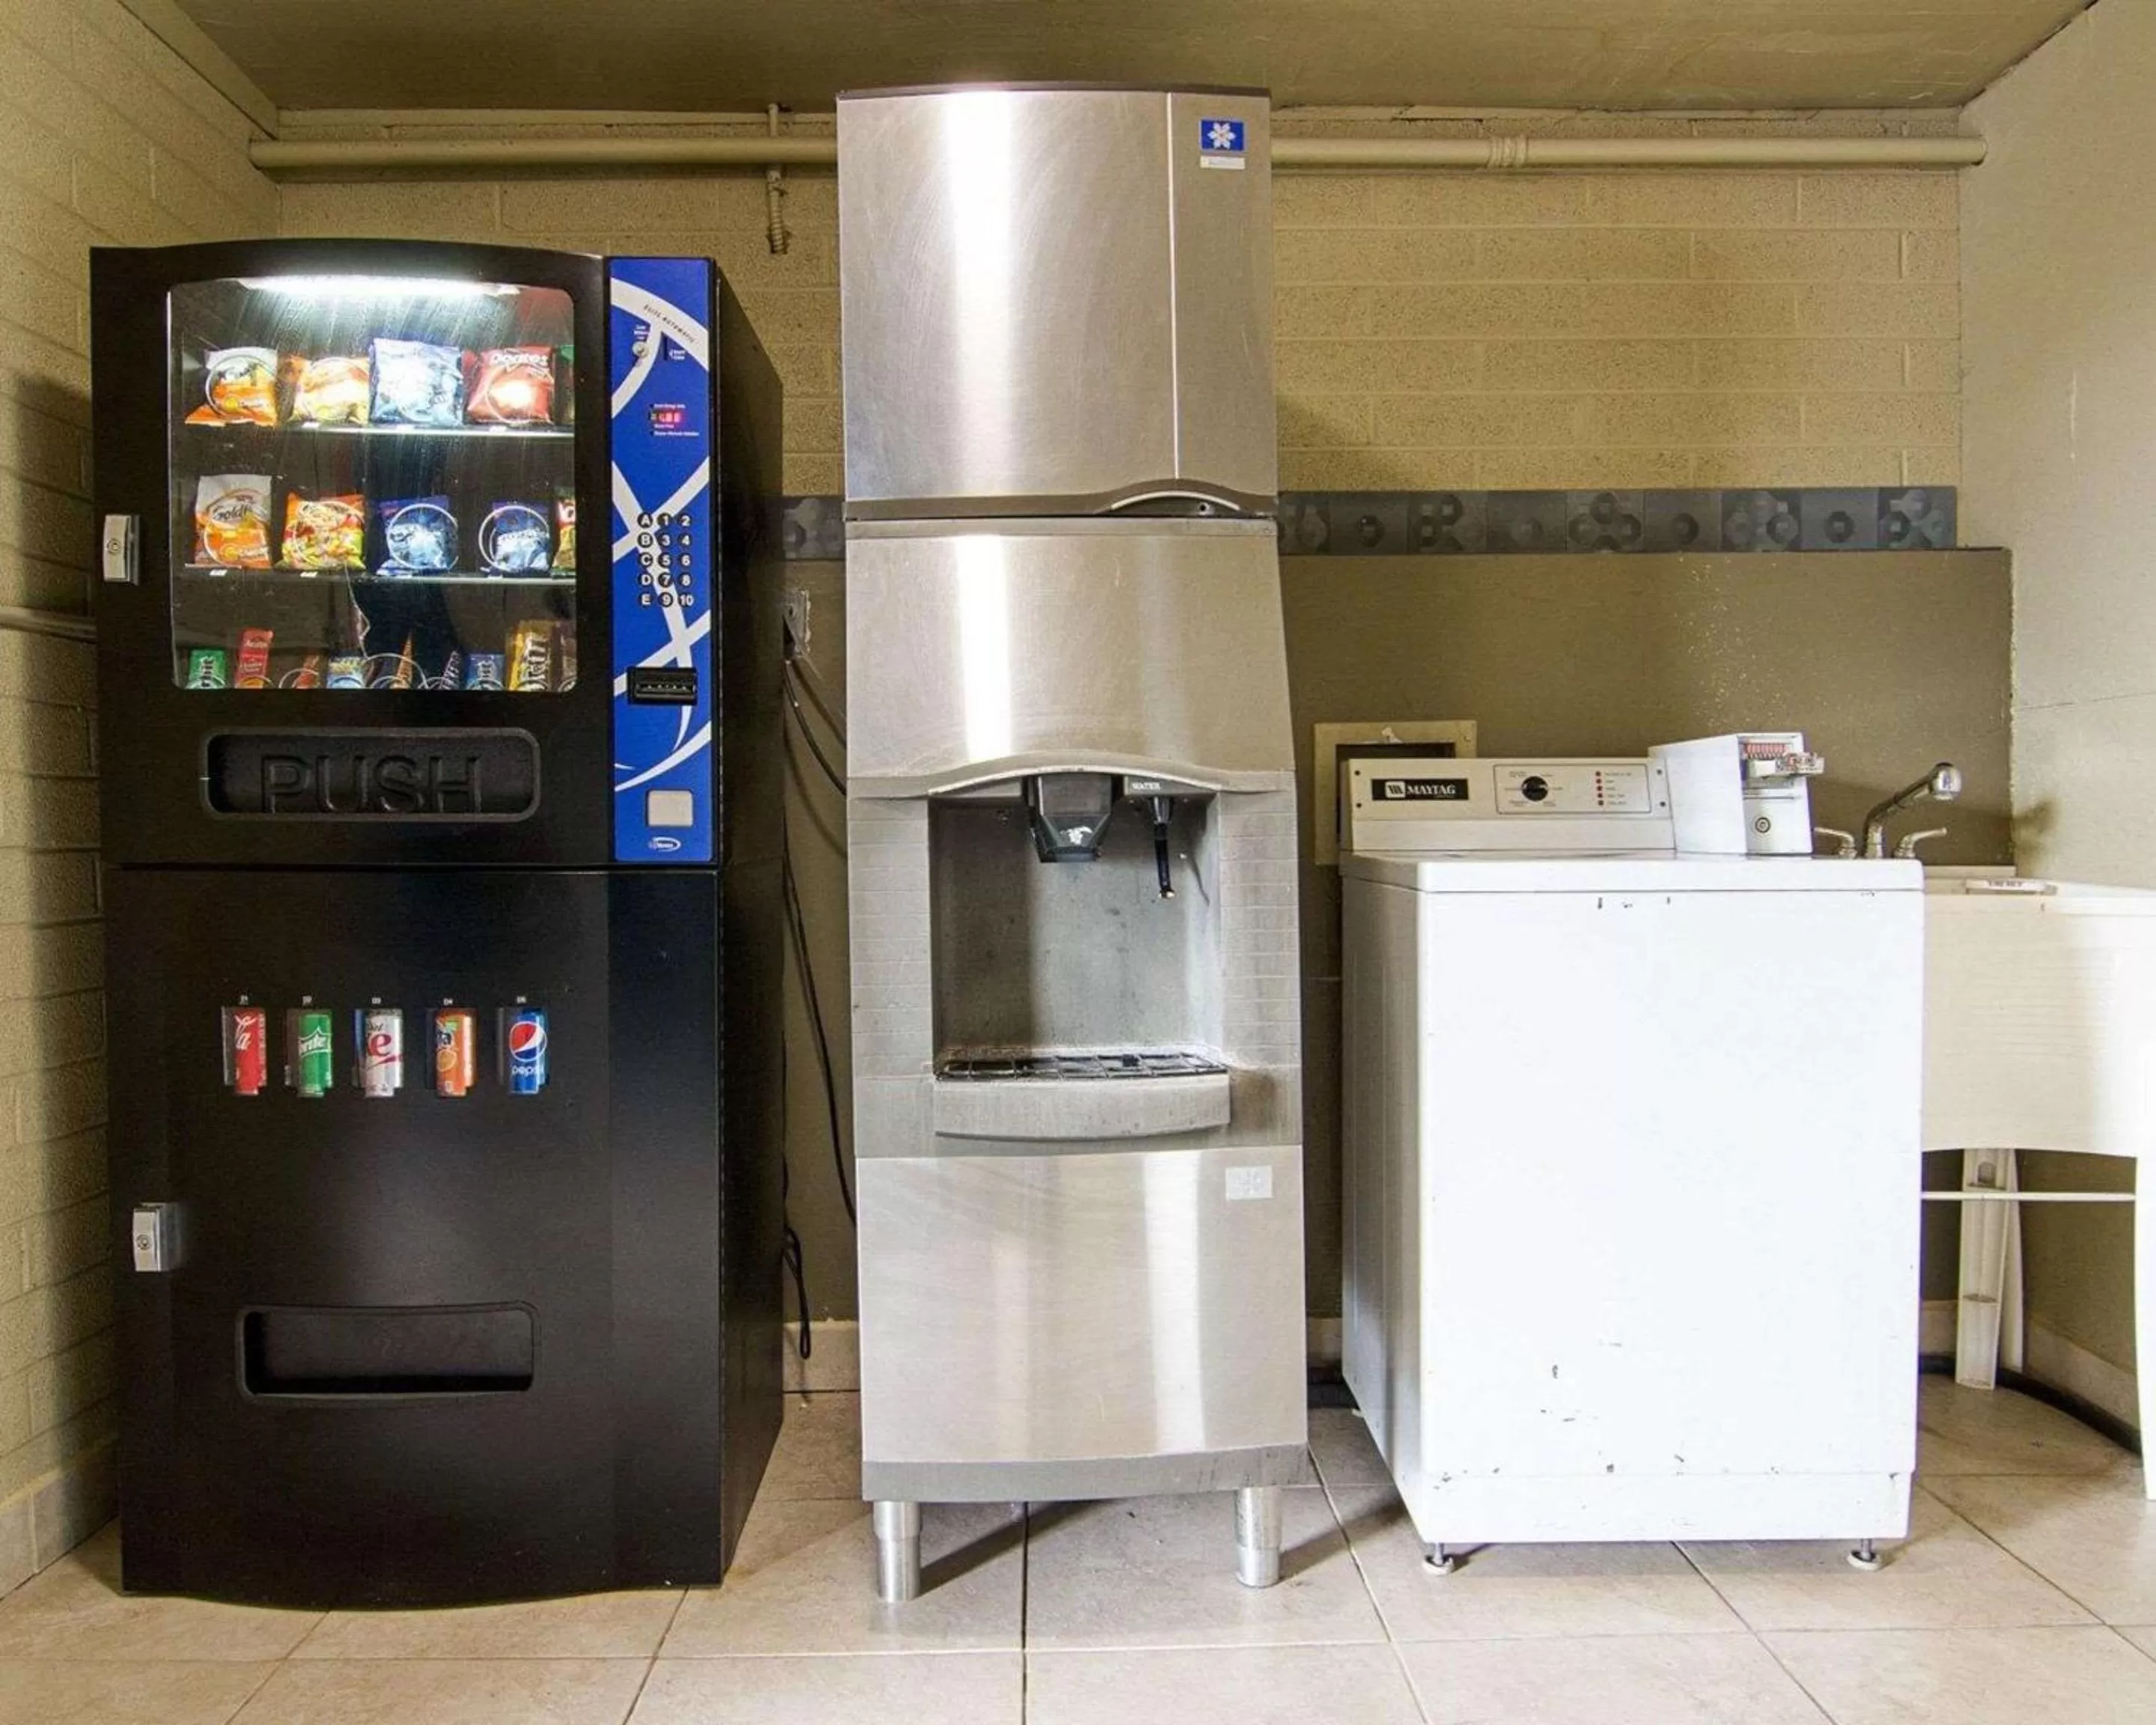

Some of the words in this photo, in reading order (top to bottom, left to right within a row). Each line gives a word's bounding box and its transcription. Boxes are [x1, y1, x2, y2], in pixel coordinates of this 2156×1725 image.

[642, 514, 649, 526] A
[663, 515, 669, 526] 1
[680, 515, 689, 526] 2
[642, 535, 649, 545] B
[663, 535, 671, 545] 3
[680, 535, 689, 545] 4
[642, 555, 650, 565] C
[663, 555, 671, 565] 5
[682, 555, 690, 565] 6
[642, 575, 651, 585] D
[663, 575, 671, 585] 7
[681, 575, 690, 585] 8
[642, 595, 651, 605] E
[663, 594, 671, 605] 9
[680, 594, 694, 606] 10
[263, 755, 483, 814] PUSH
[1407, 784, 1456, 795] MAYTAG
